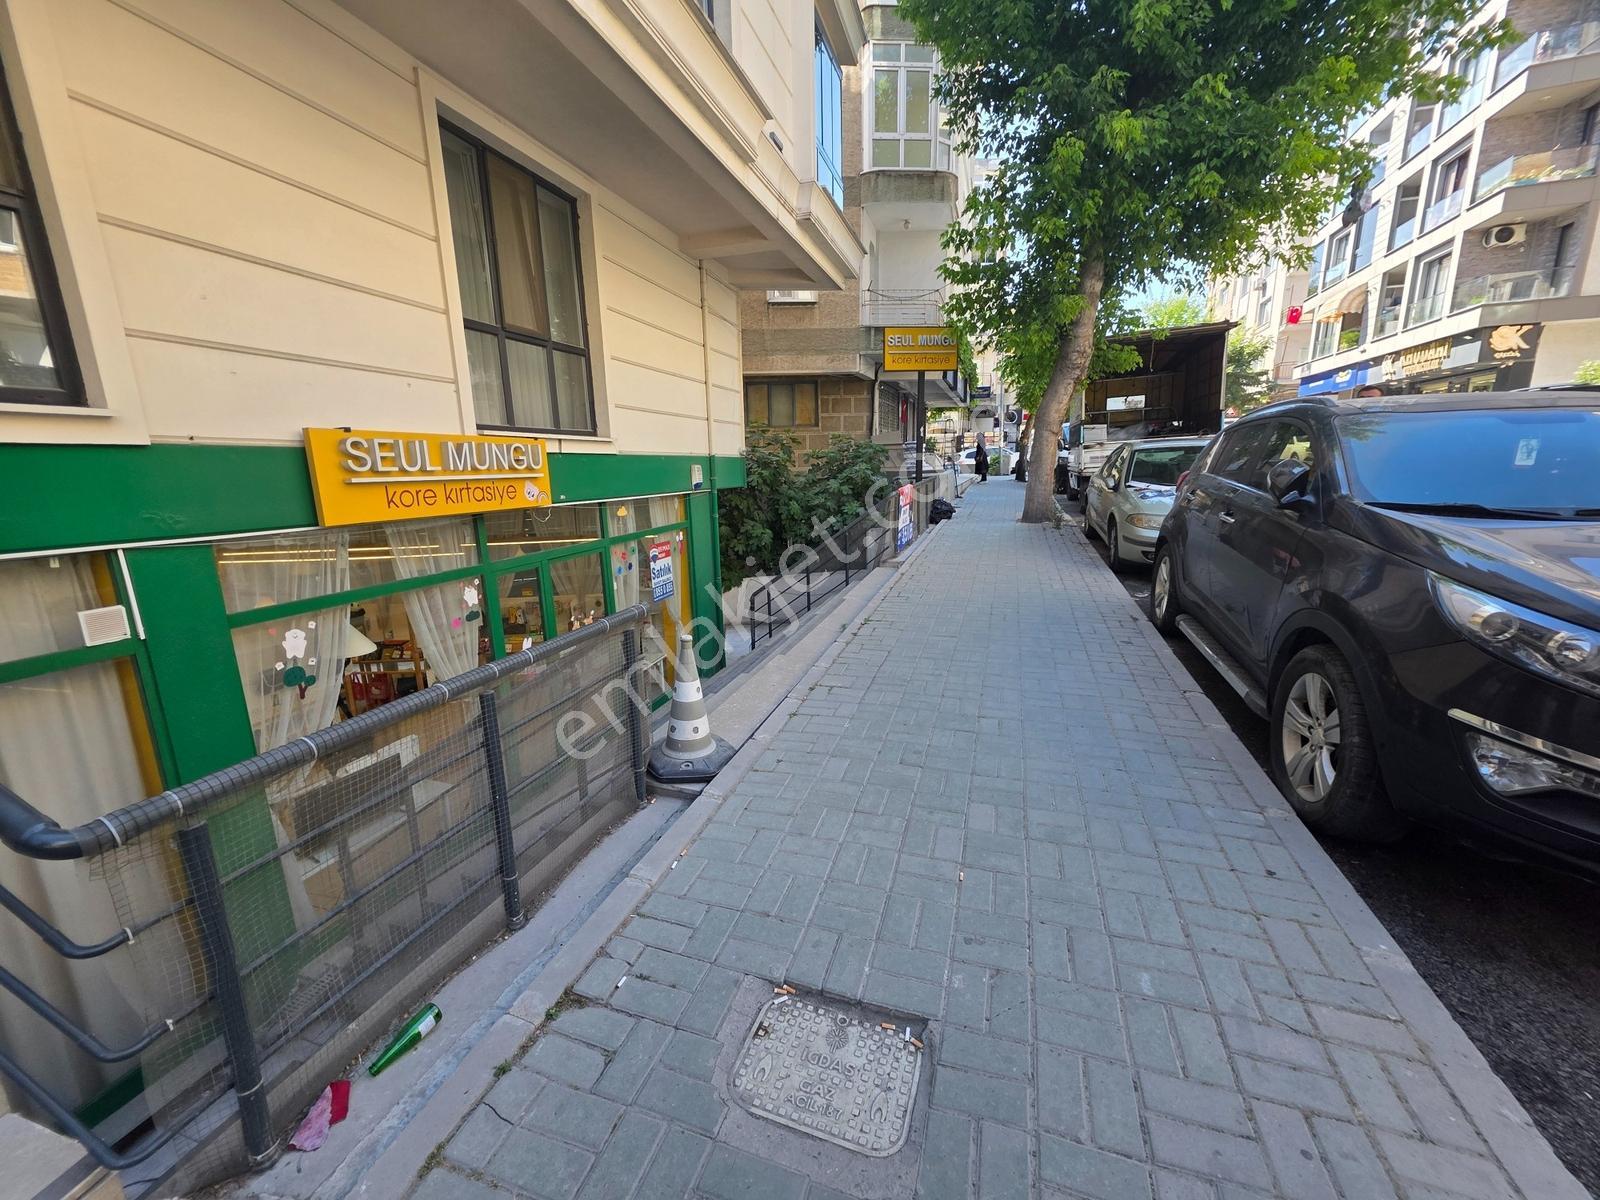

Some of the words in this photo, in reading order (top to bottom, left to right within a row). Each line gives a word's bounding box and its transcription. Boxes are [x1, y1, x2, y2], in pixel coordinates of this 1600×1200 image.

[887, 334, 916, 346] SEUL
[891, 355, 913, 365] kore
[342, 436, 442, 473] SEUL
[446, 440, 543, 471] MUNGU
[384, 485, 438, 509] kore
[443, 480, 518, 505] kırtasiye
[799, 1079, 836, 1102] GAZ
